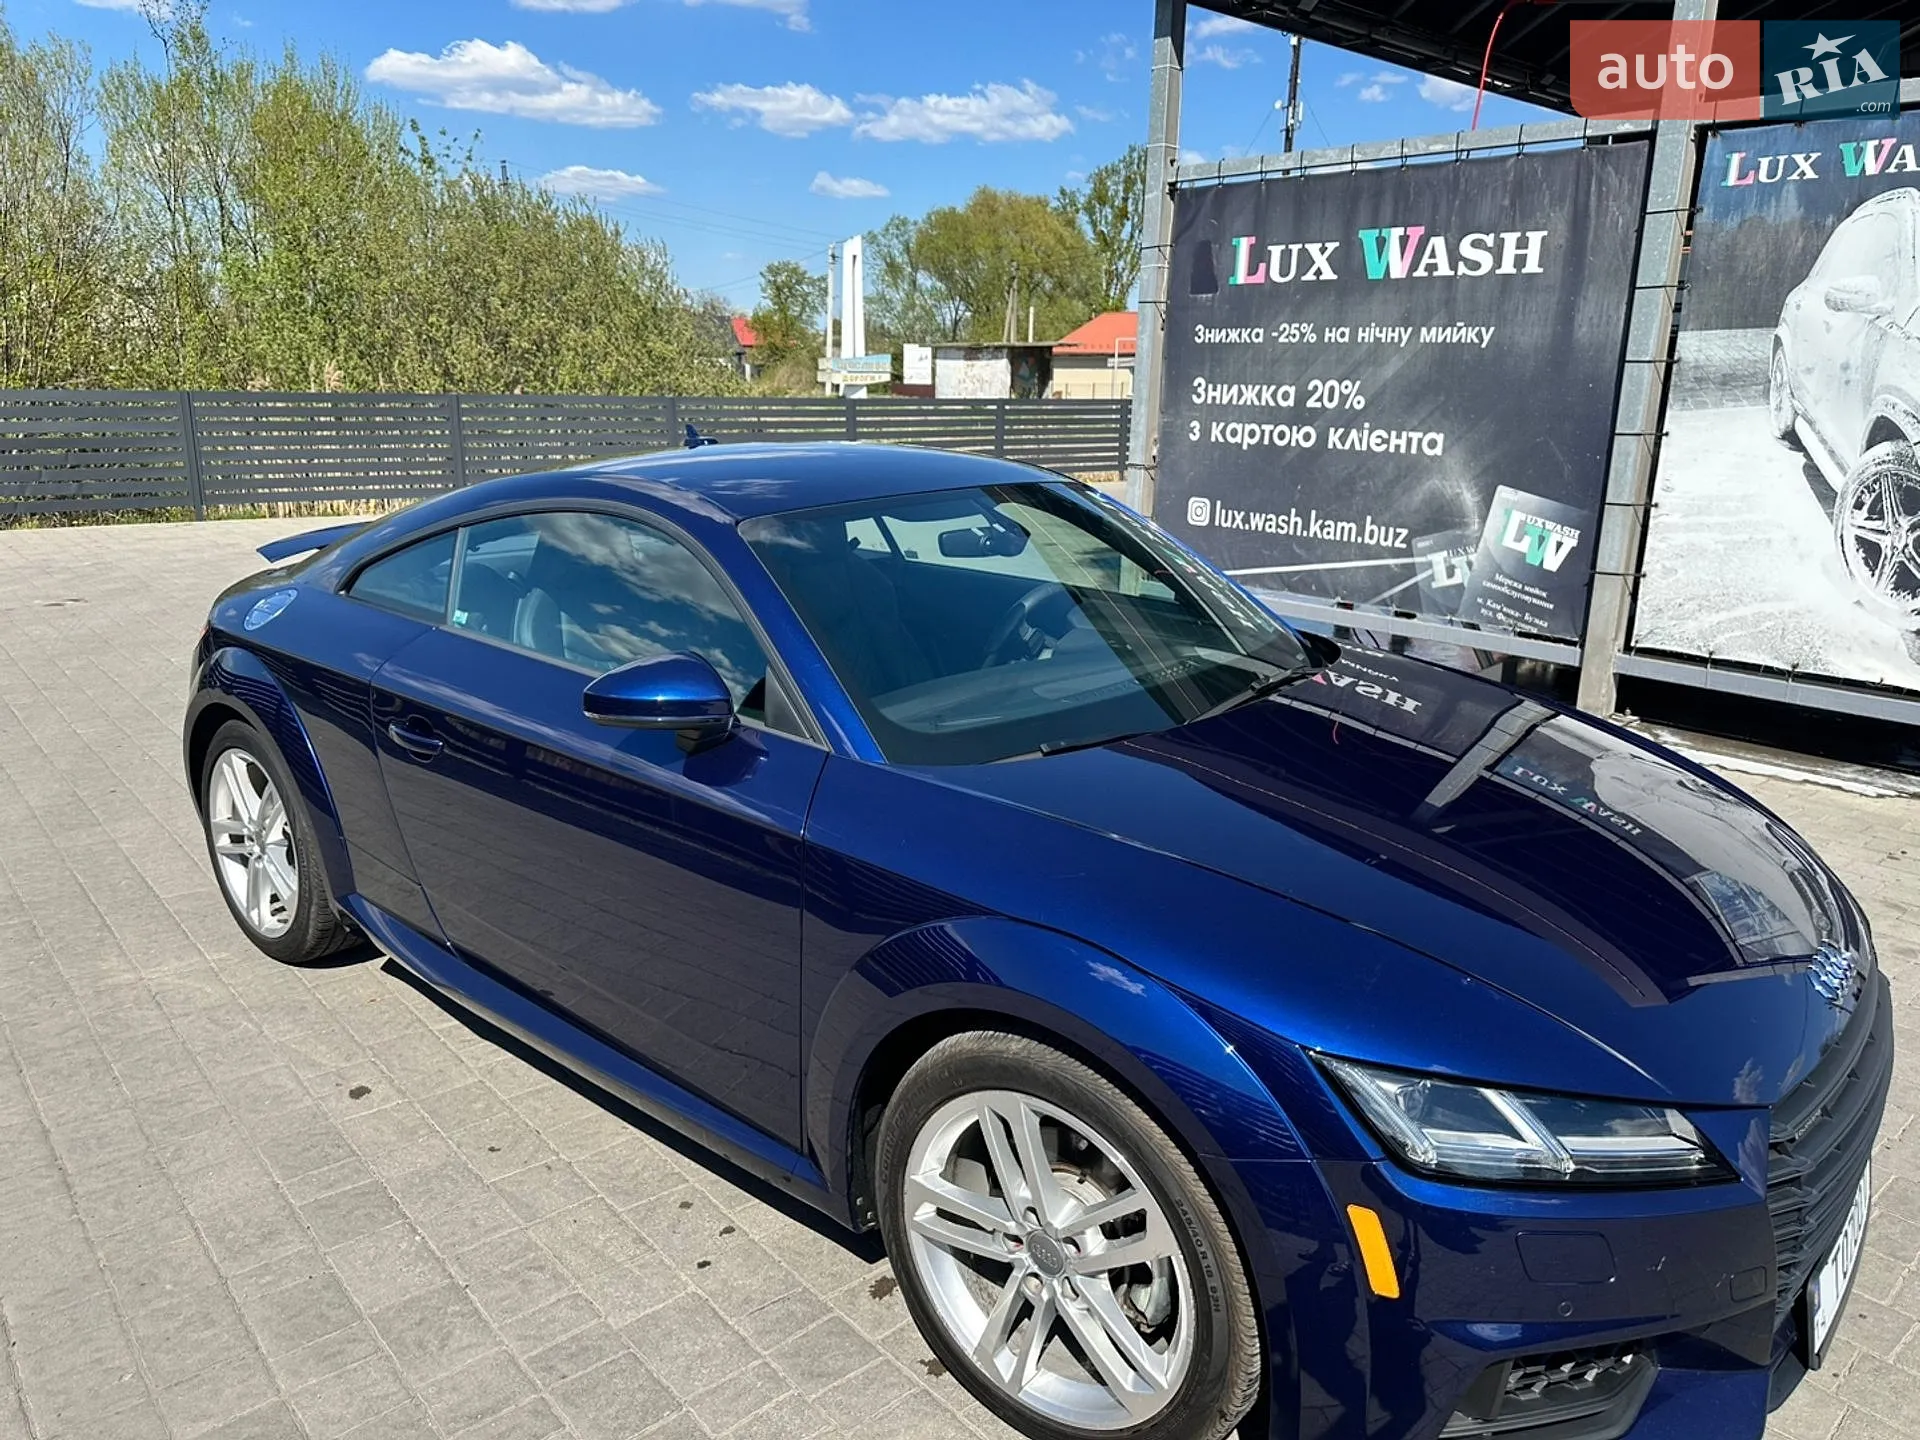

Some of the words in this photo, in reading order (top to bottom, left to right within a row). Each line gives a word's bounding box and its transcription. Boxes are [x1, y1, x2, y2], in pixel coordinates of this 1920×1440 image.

[1720, 151, 1822, 188] LUX
[1838, 137, 1920, 178] WA
[1228, 235, 1340, 285] LUX
[1358, 226, 1549, 280] WASH
[1194, 323, 1264, 344] Знижка
[1271, 322, 1317, 343] -25%
[1324, 326, 1349, 343] на
[1357, 322, 1413, 348] нічну
[1420, 322, 1496, 348] мийку
[1191, 376, 1296, 408] Знижка
[1306, 379, 1366, 410] 20%
[1188, 420, 1201, 441] з
[1210, 421, 1318, 450] картою
[1327, 423, 1445, 457] клієнта
[1214, 500, 1410, 549] lux.wash.kam.buz
